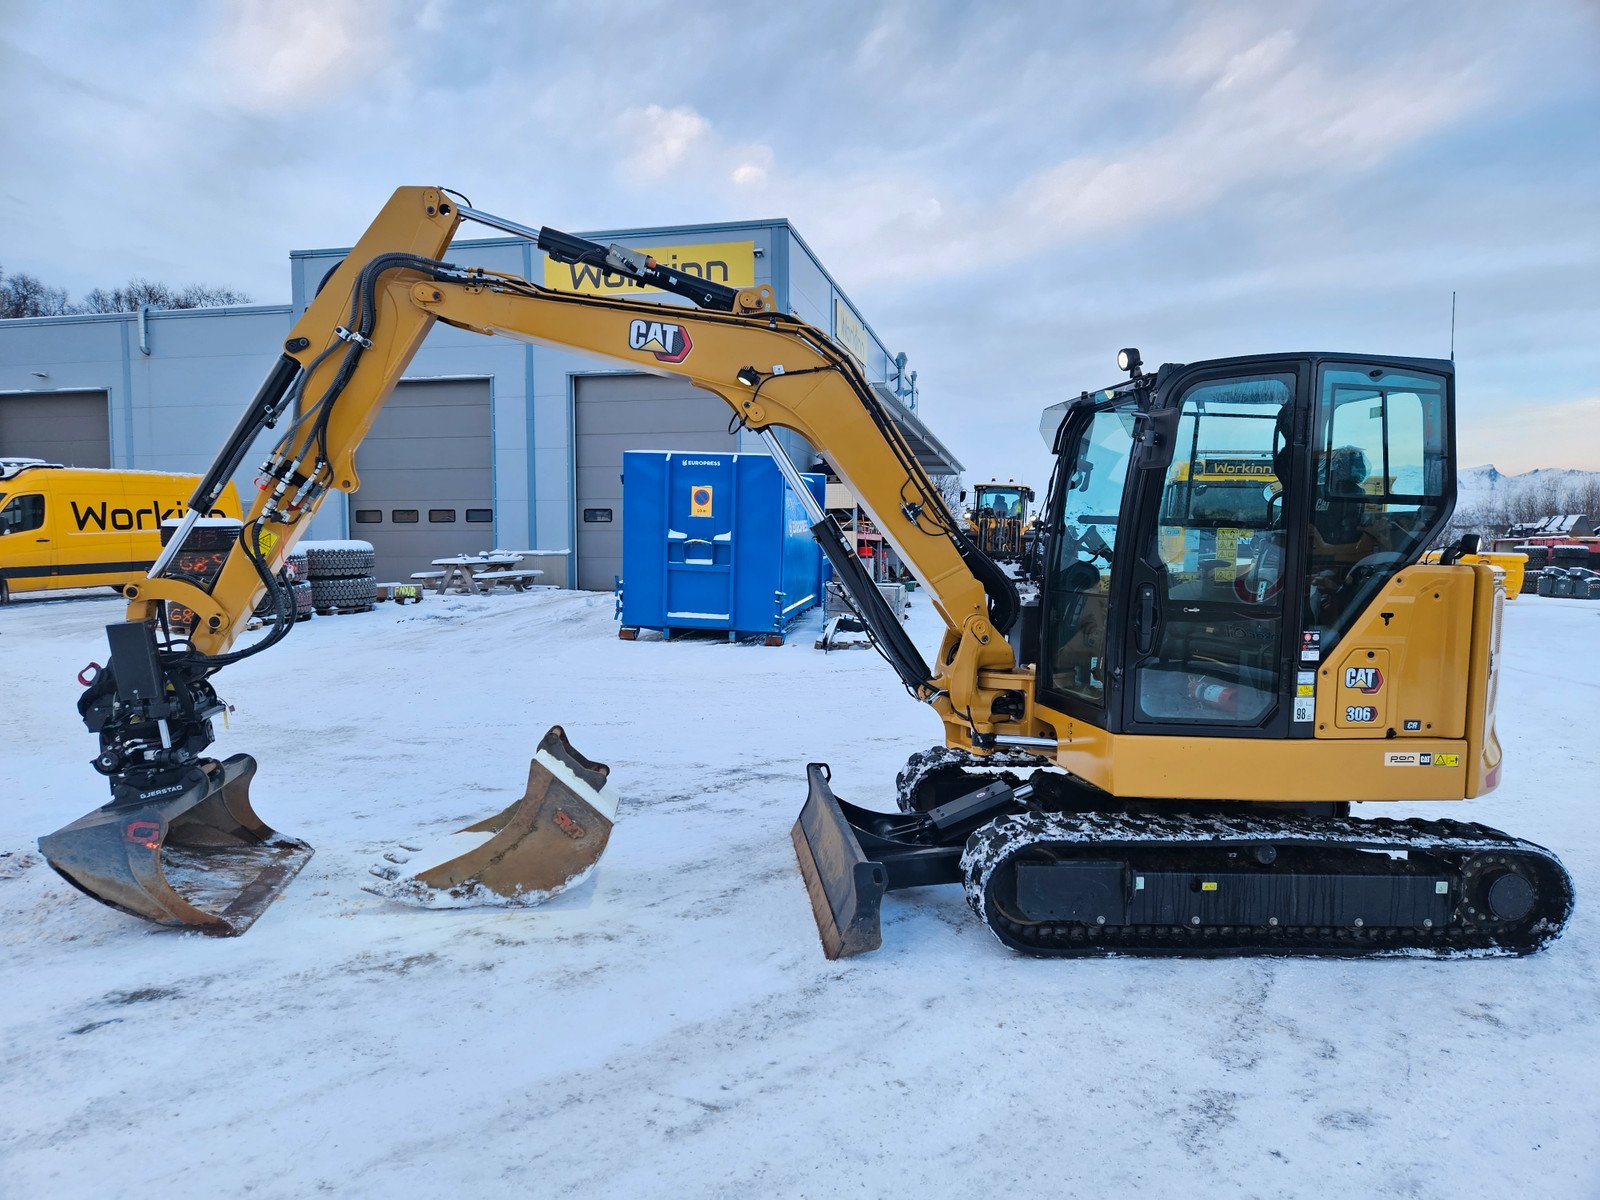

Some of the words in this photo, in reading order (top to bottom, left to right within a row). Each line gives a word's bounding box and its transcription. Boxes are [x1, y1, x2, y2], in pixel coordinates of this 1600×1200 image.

[568, 255, 728, 290] Woinn
[630, 319, 679, 354] CAT
[1214, 463, 1272, 474] Workinn
[1346, 668, 1376, 688] CAT
[1296, 707, 1306, 720] 98
[1346, 706, 1371, 721] 306
[1406, 721, 1418, 729] CR
[1420, 755, 1431, 763] CAT
[140, 784, 183, 799] GJERSTAD
